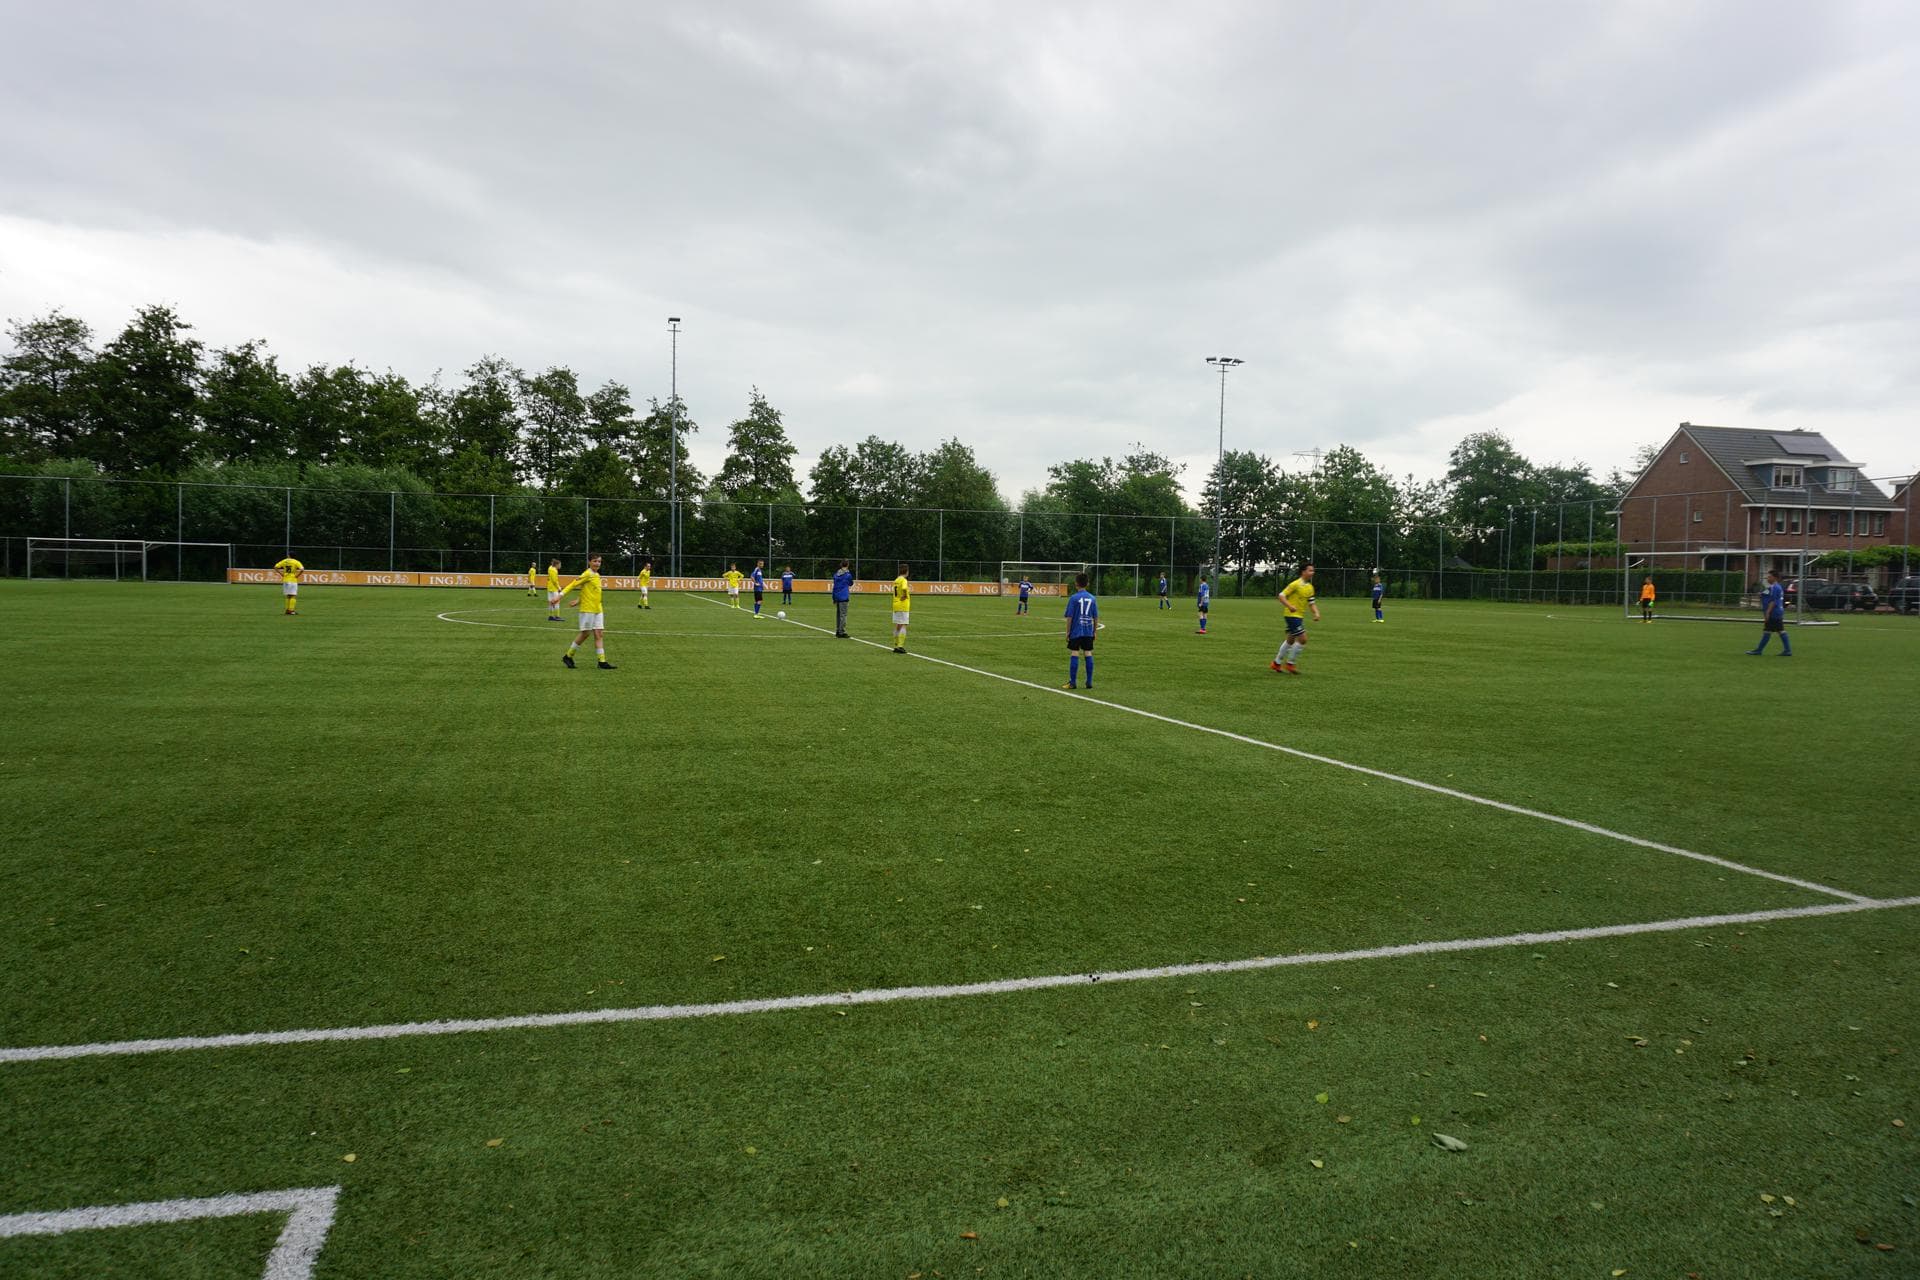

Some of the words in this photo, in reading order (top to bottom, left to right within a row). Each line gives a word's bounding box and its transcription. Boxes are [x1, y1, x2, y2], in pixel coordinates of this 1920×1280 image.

[238, 572, 263, 581] ING
[303, 574, 328, 583] ING
[367, 575, 391, 584] ING
[430, 576, 454, 585] ING
[490, 577, 513, 586] ING
[615, 579, 657, 588] SPIT
[664, 579, 778, 590] JEUGDOPEIDNG
[929, 585, 950, 593] ING
[980, 585, 999, 594] ING
[1030, 585, 1047, 595] NG
[1078, 597, 1092, 615] 17
